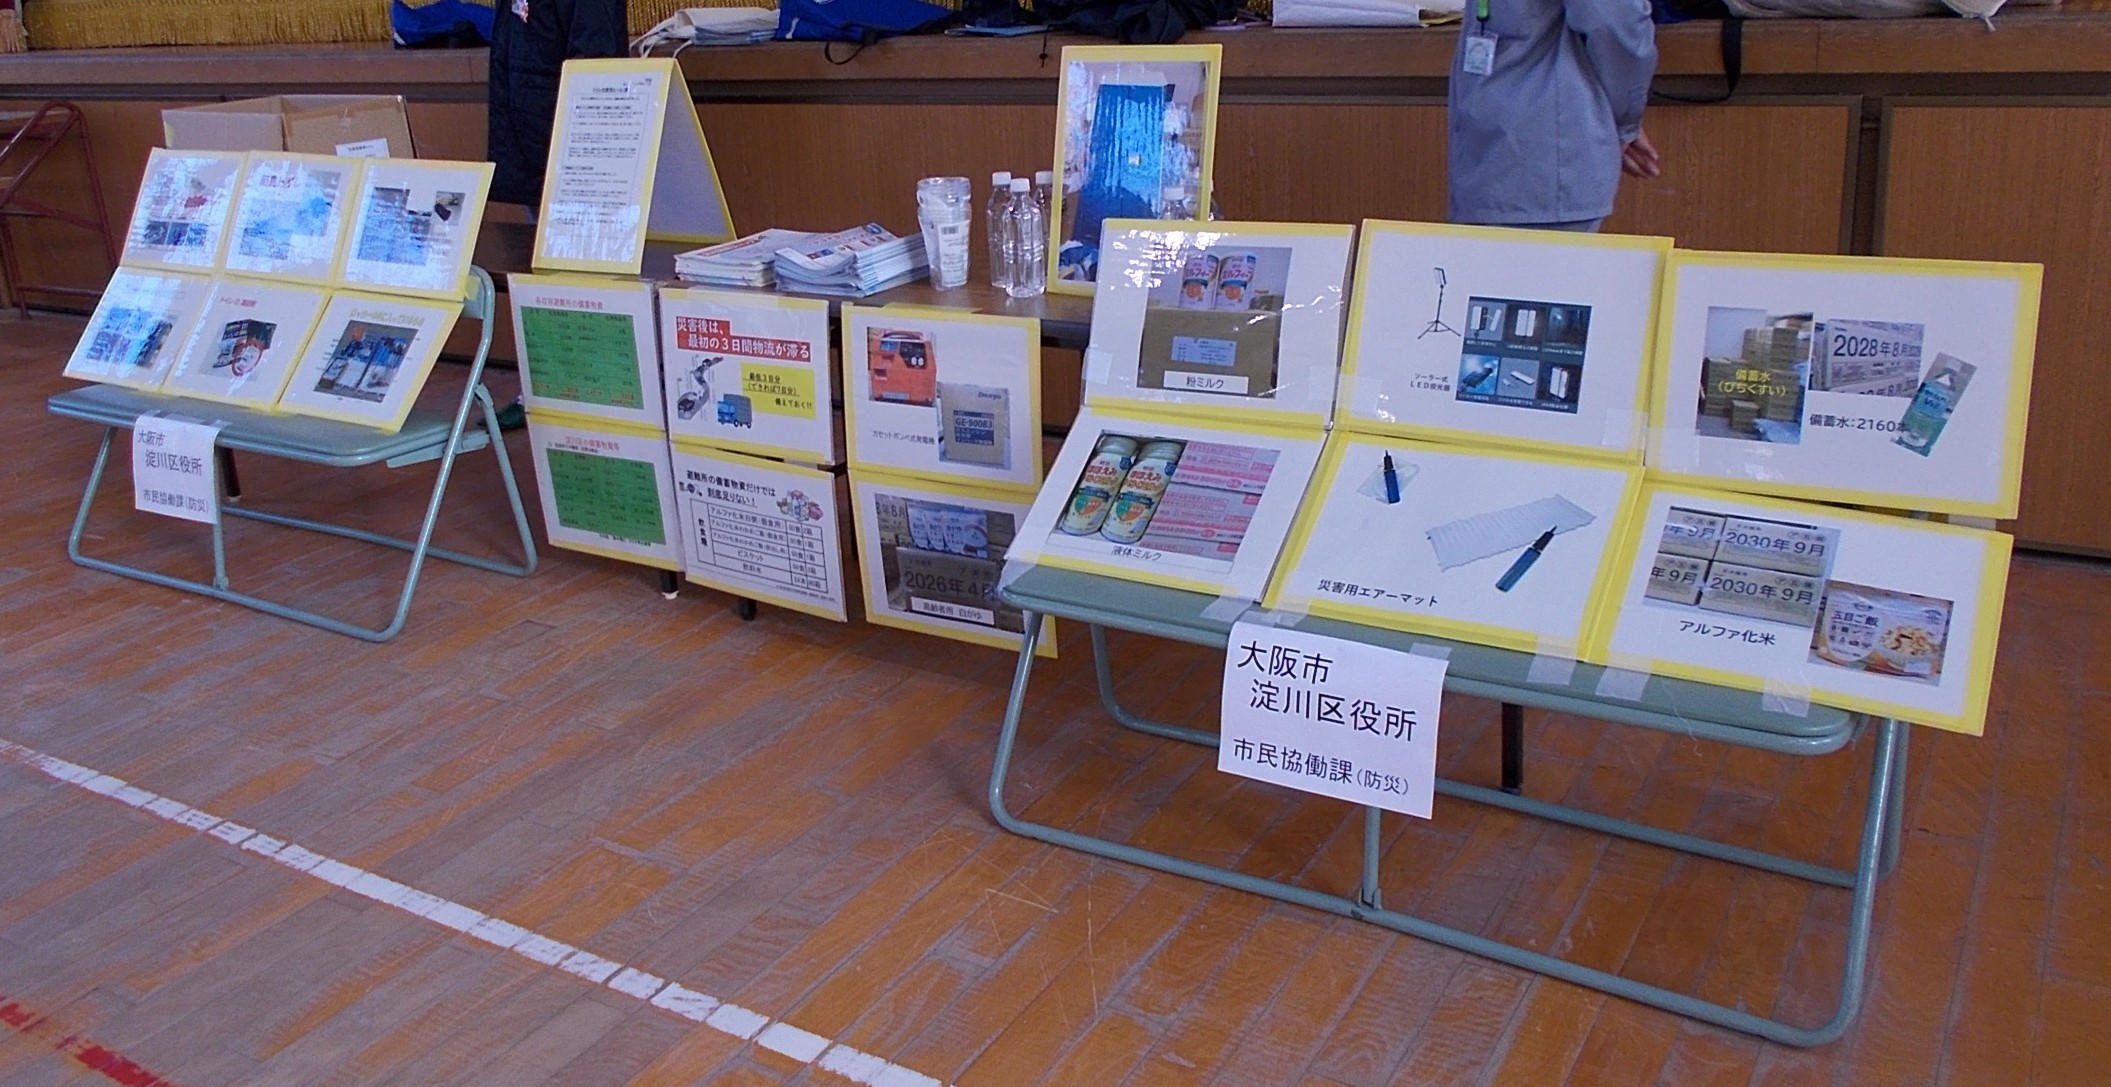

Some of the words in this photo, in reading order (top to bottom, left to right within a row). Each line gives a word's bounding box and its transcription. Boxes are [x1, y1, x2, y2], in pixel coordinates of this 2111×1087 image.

[676, 316, 725, 335] 災害後は、
[688, 333, 810, 359] 最初の3日間物流が滞る
[1185, 375, 1225, 389] 粉ミルク
[1414, 373, 1448, 383] ソーラー式
[1735, 368, 1772, 382] 備蓄水
[1718, 381, 1787, 397] （びちくすい）
[137, 429, 166, 447] 大阪市
[872, 429, 935, 445] カセットボンベ式発電機
[145, 448, 203, 476] 淀川区役所
[686, 469, 776, 497] 避難所の備蓄物資だけでは
[1129, 470, 1162, 482] ほほえみ
[143, 489, 209, 513] 市民協働課（防災）
[1663, 524, 1716, 541] 年9月
[1724, 531, 1825, 557] 2030年9月
[737, 549, 764, 561] ビスケット
[1112, 545, 1162, 561] 液体ミルク
[1316, 578, 1438, 607] 災害用エアーマット
[1709, 576, 1814, 605] 2030年9月
[922, 601, 954, 617] 高齢者用
[1831, 610, 1880, 628] 五目ご飯
[1679, 619, 1777, 646] アルファ化米
[1236, 639, 1334, 685] 大阪市
[1249, 678, 1417, 742] 淀川区役所
[1232, 737, 1409, 796] 市民協働課（防災）
